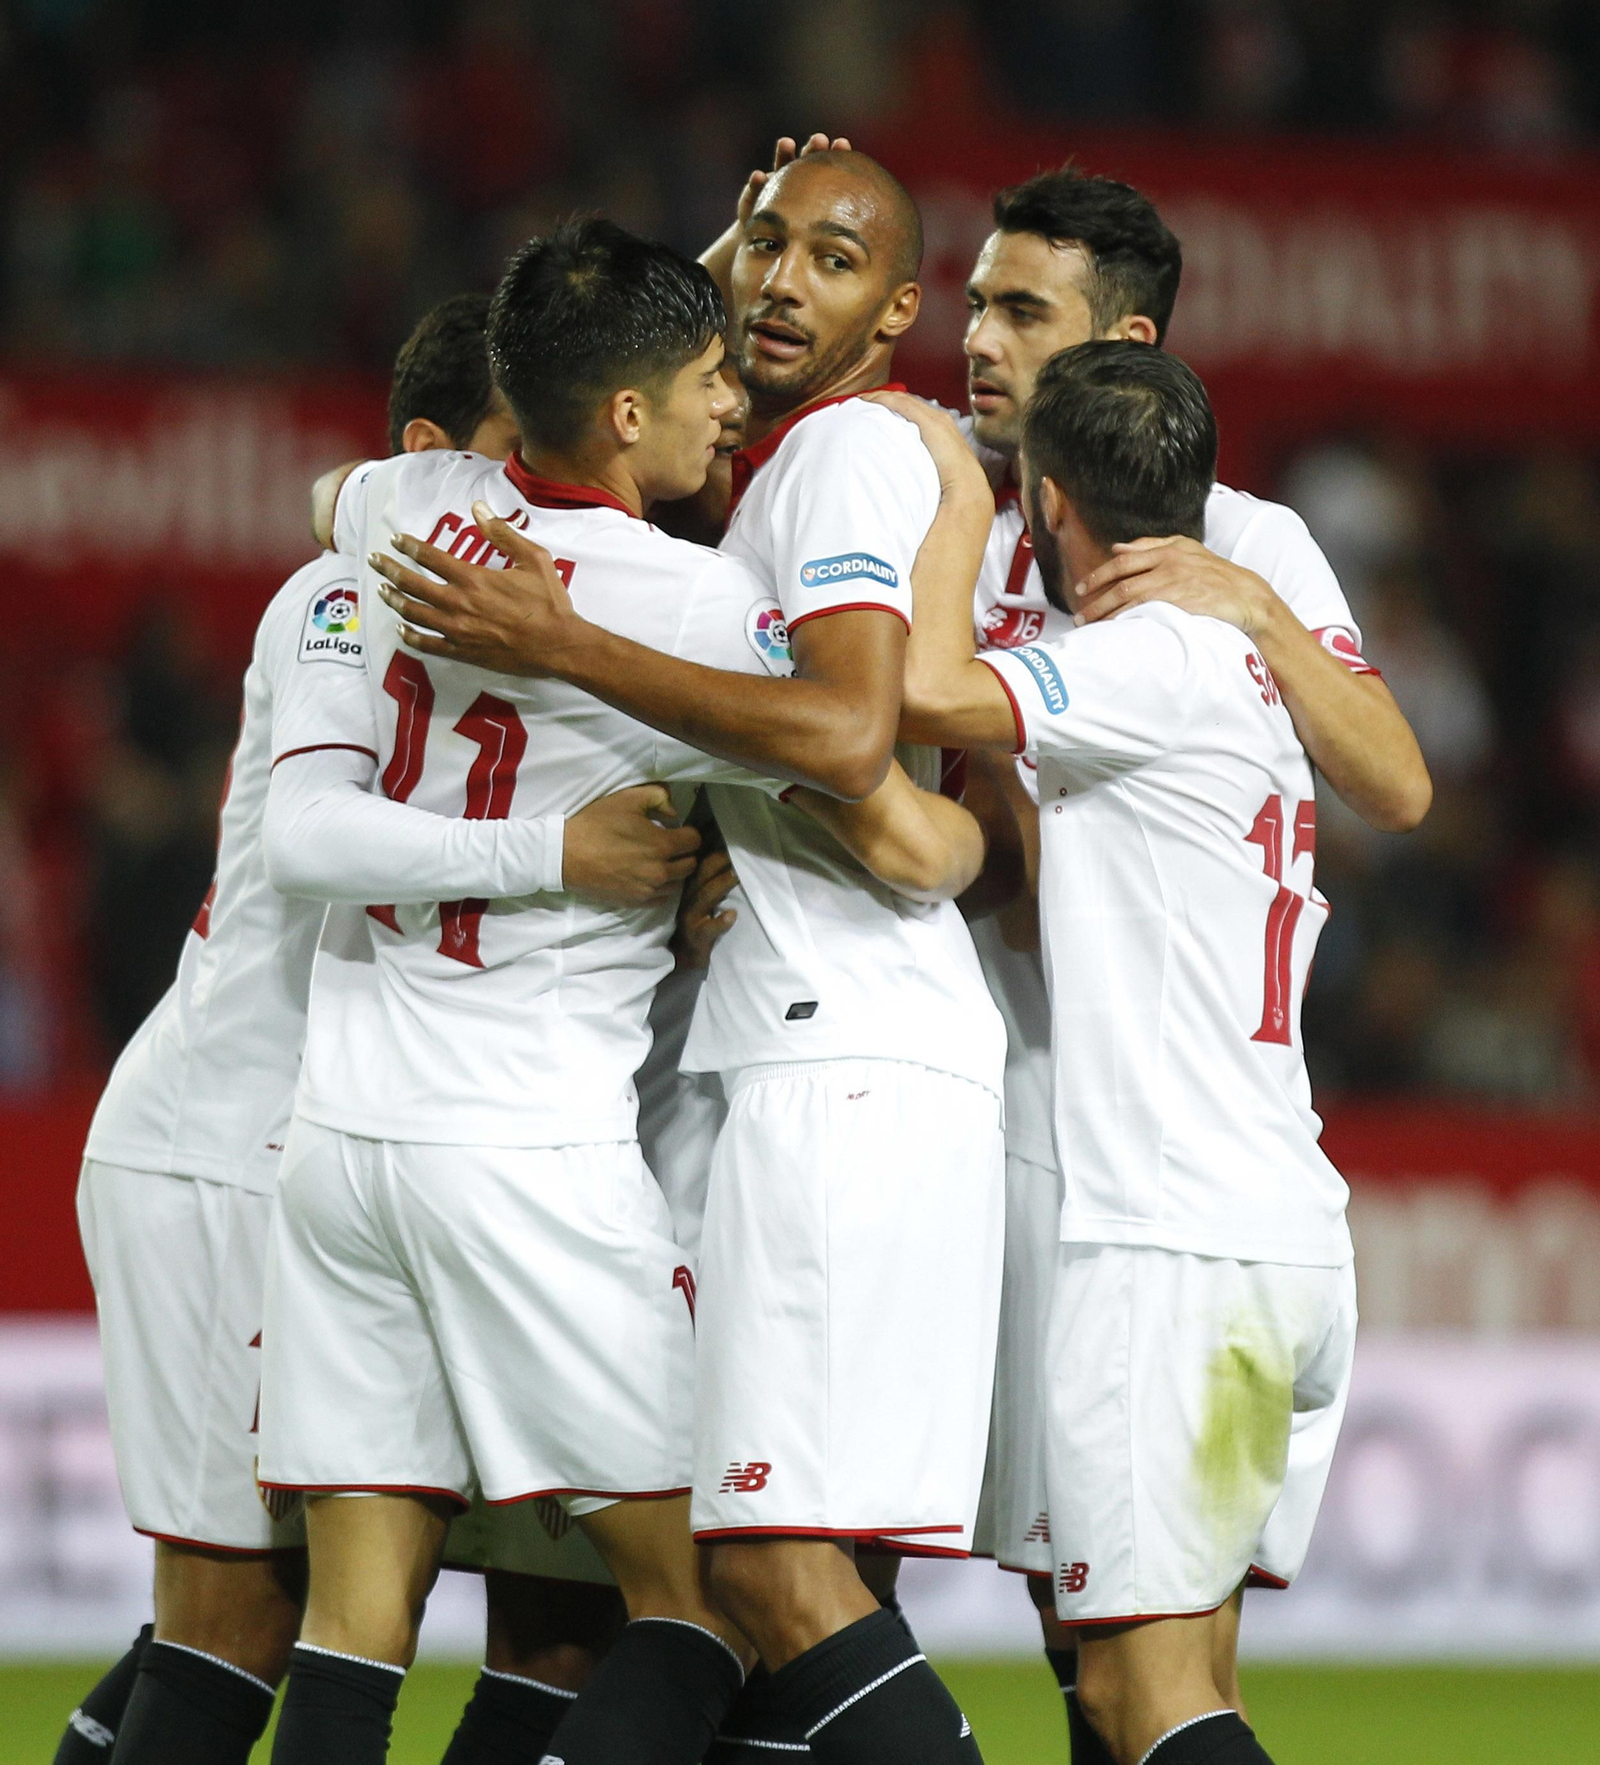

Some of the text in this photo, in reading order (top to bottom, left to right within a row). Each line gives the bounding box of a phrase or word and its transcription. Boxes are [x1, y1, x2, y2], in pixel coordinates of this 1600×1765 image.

[816, 558, 896, 583] CORDIALITY
[306, 637, 361, 655] LaLiga
[365, 648, 529, 969] 11
